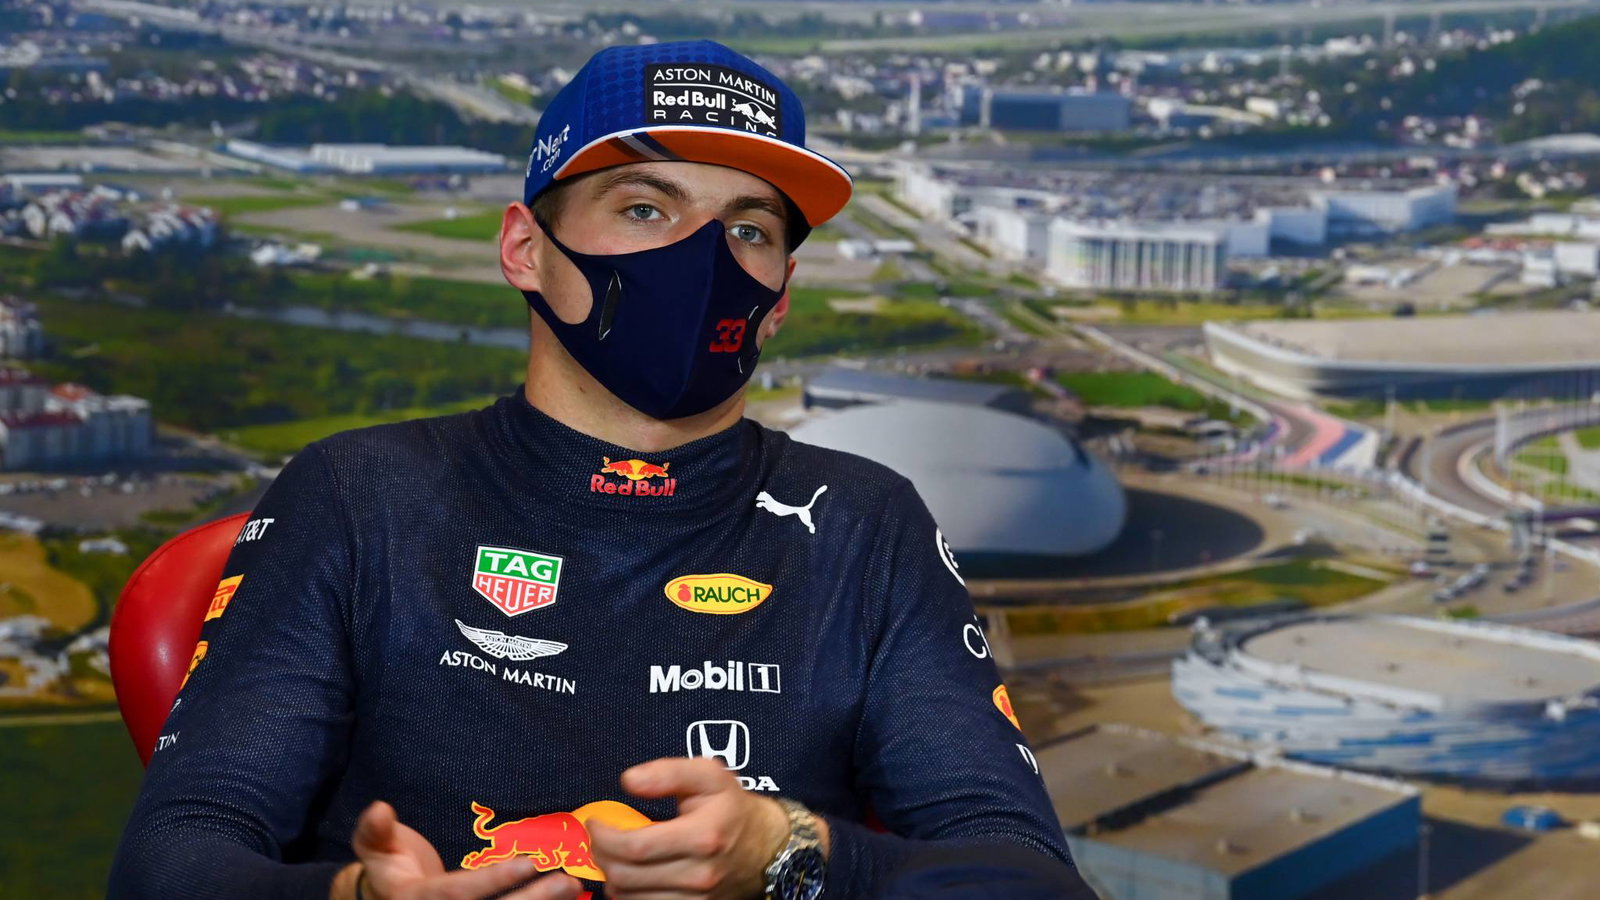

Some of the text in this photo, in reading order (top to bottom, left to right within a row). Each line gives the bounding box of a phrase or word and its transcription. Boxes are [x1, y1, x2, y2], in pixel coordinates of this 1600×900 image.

[653, 89, 726, 110] Red Bull
[654, 69, 776, 106] ASTON MARTIN
[541, 148, 561, 174] .com
[709, 318, 747, 353] 33
[590, 474, 677, 496] Red Bull
[485, 552, 553, 581] TAG
[478, 576, 552, 611] HEUER
[694, 586, 760, 603] RAUCH
[963, 614, 993, 659] Ci
[439, 650, 576, 695] ASTON MARTIN
[649, 660, 744, 693] Mobil
[155, 731, 180, 752] TIN
[735, 776, 780, 791] DA
